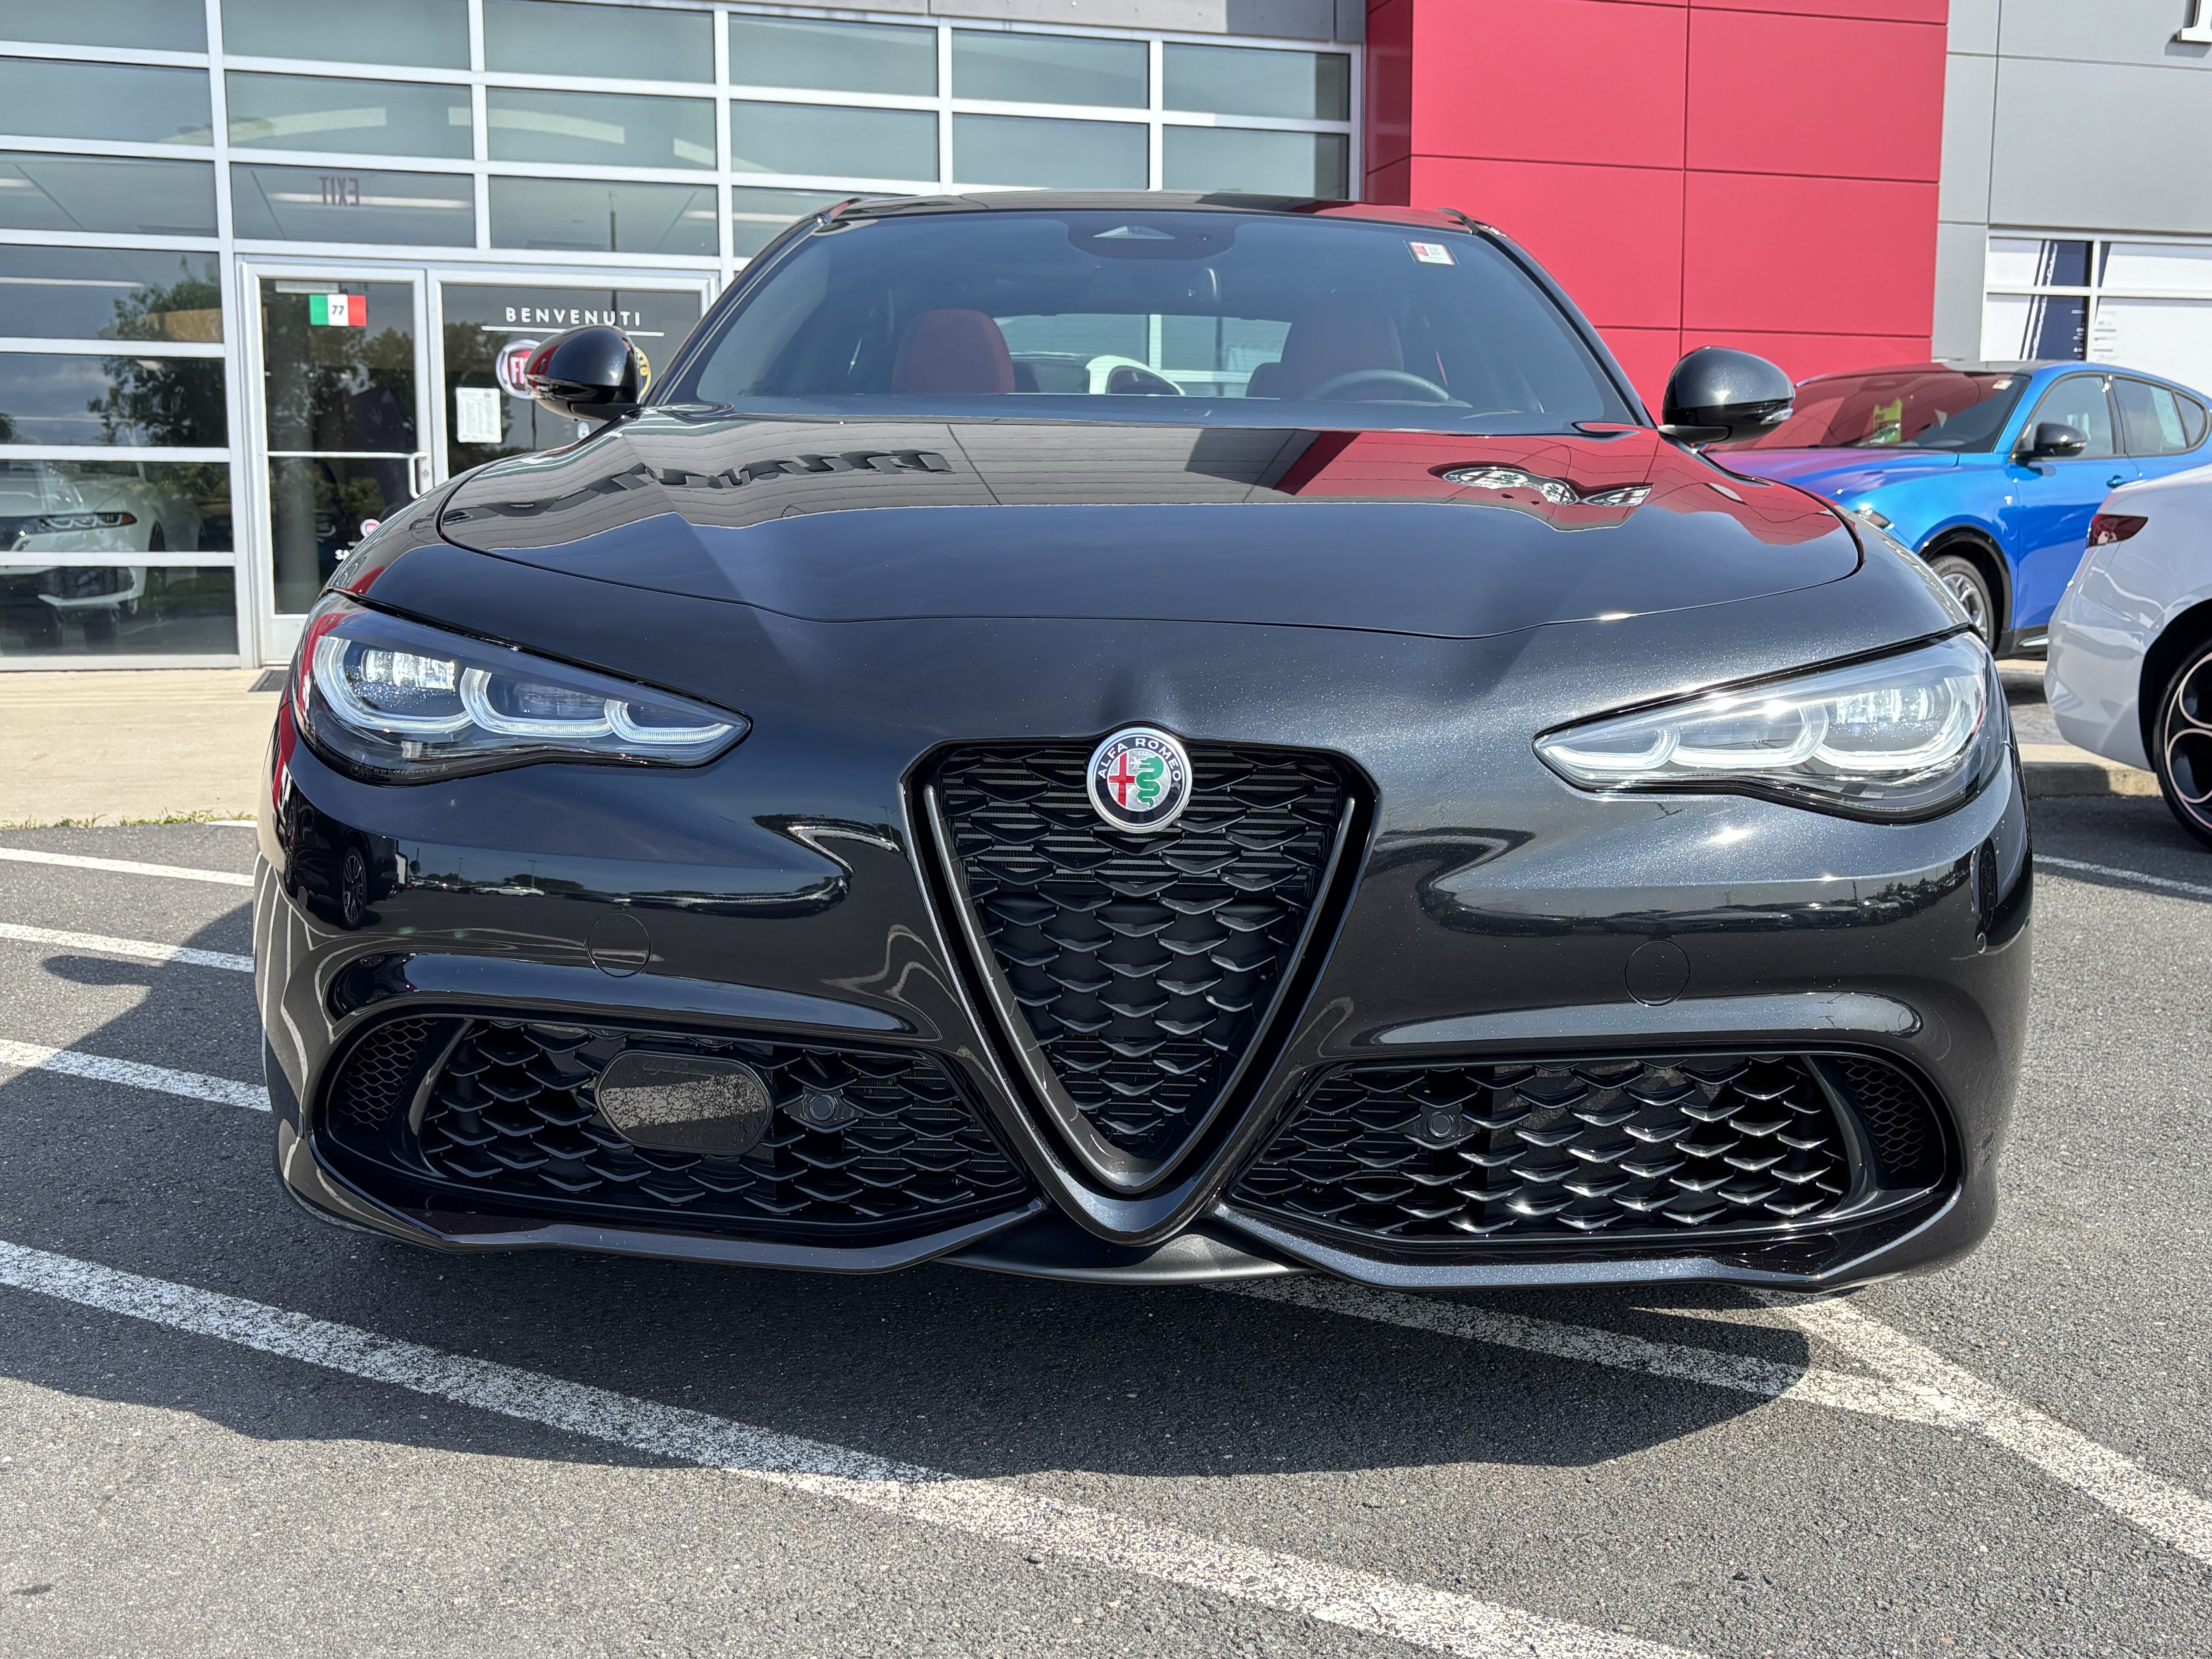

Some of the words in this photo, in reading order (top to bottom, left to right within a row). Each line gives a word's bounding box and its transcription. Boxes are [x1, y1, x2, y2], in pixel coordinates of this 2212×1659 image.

[332, 305, 345, 316] 77
[505, 306, 641, 326] BENVENUTI
[510, 356, 528, 385] FI
[1097, 742, 1128, 780] ALFA
[1135, 738, 1181, 781] ROMEO
